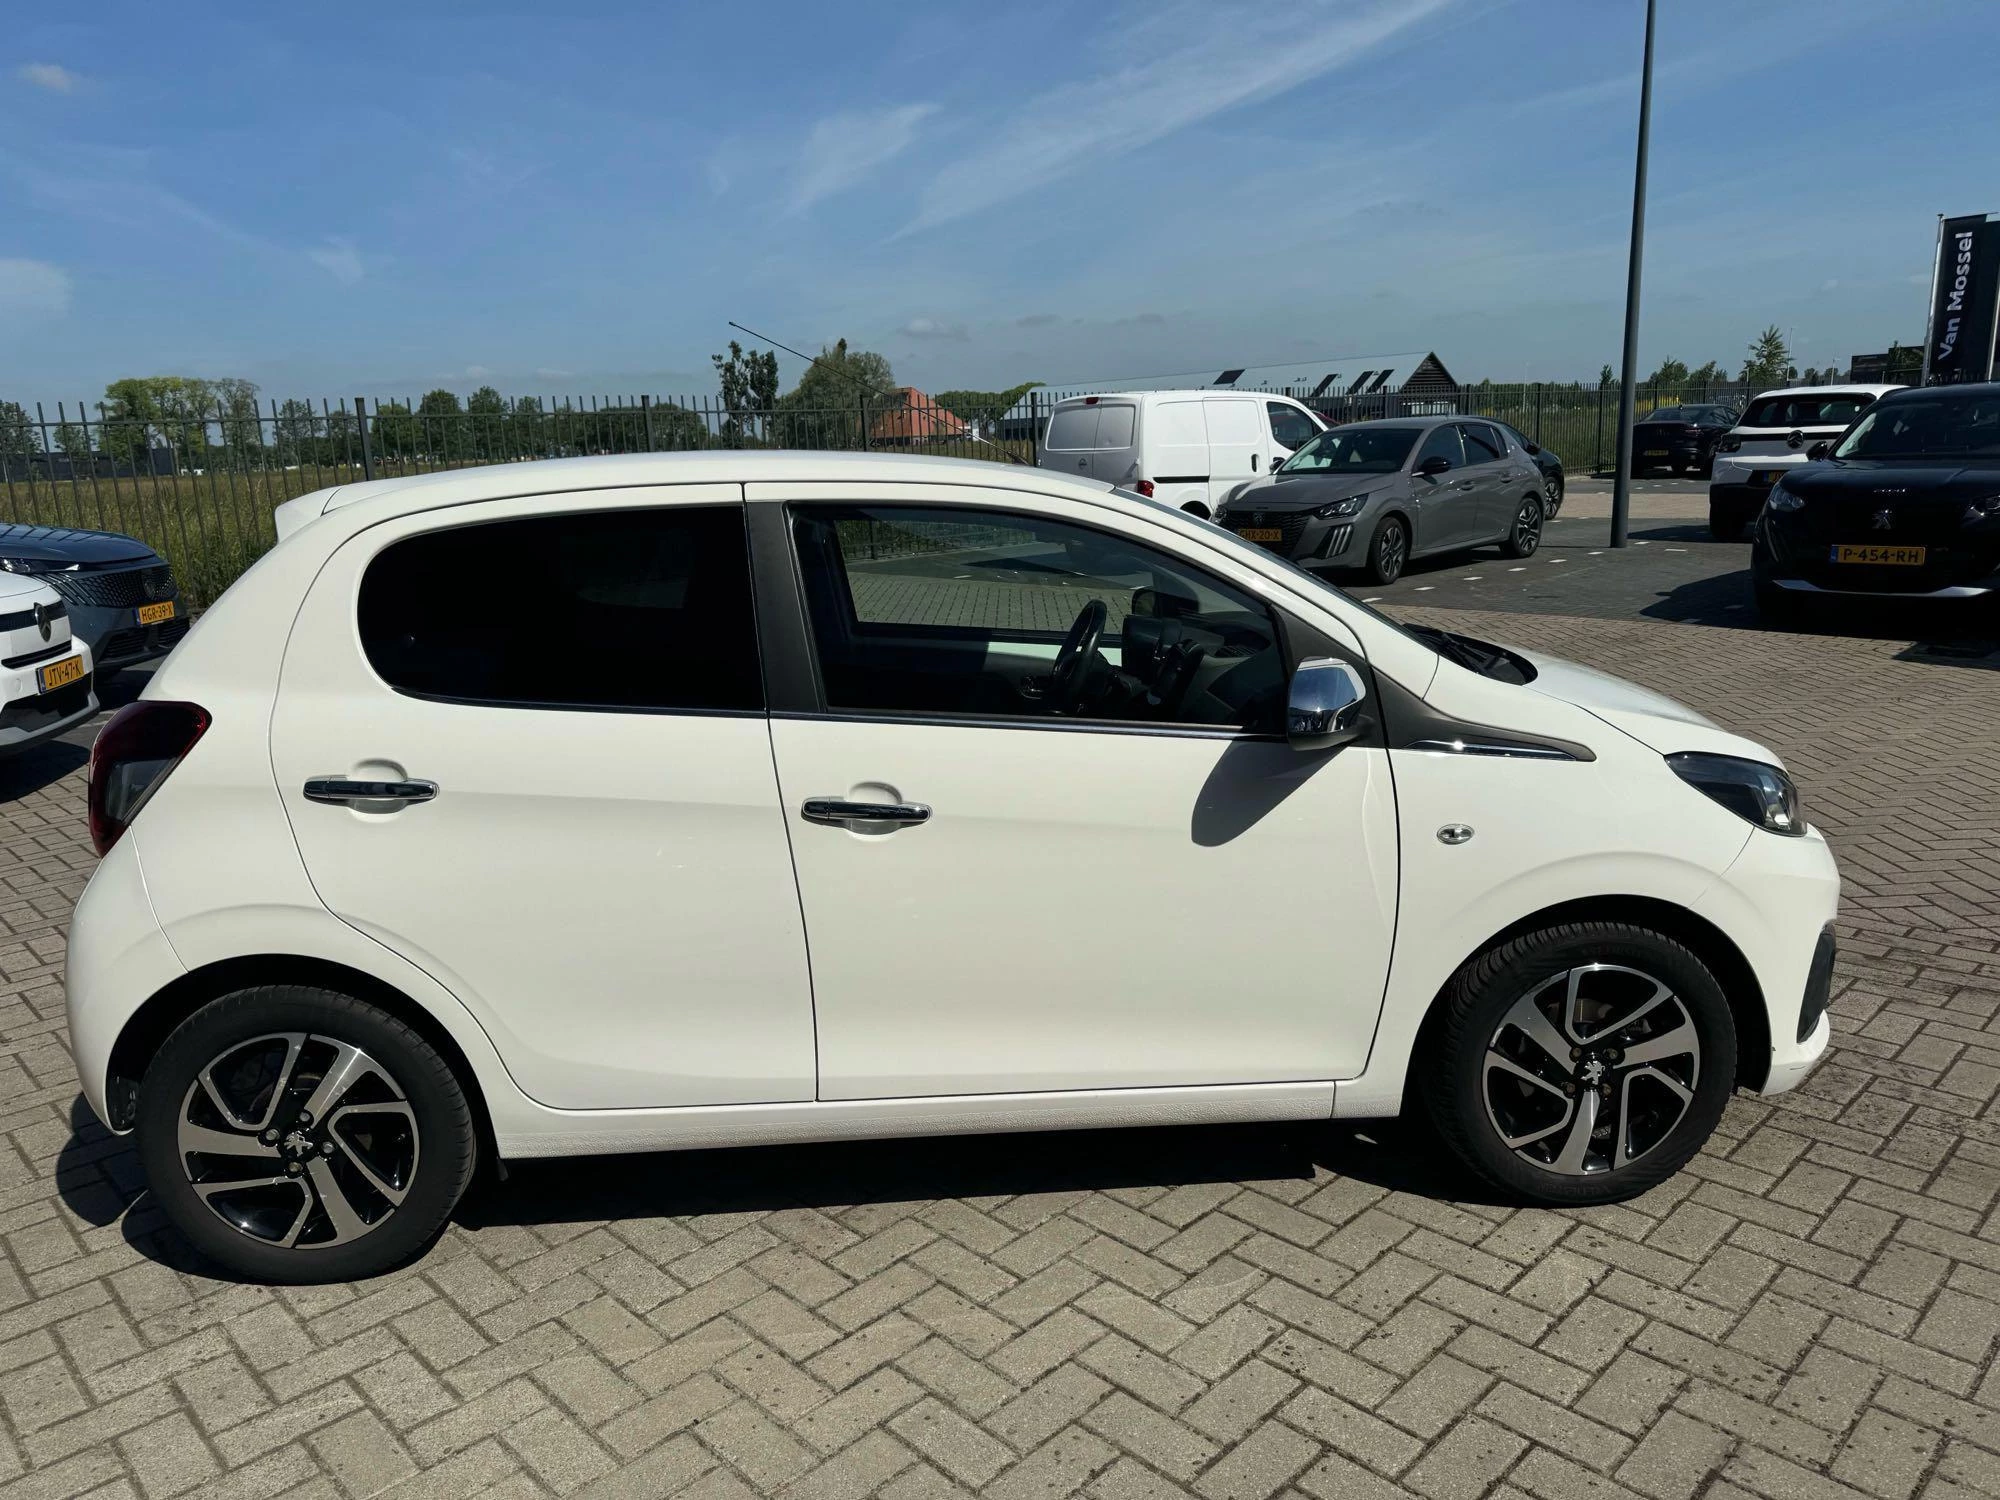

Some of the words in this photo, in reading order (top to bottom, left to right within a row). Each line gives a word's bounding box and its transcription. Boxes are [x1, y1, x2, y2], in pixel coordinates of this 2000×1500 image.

[1947, 231, 1973, 311] Mossel
[1938, 318, 1961, 360] Van
[1843, 548, 1918, 562] P-454-RH
[141, 603, 173, 622] HGR-39-X
[48, 660, 81, 686] JTV-47-K
